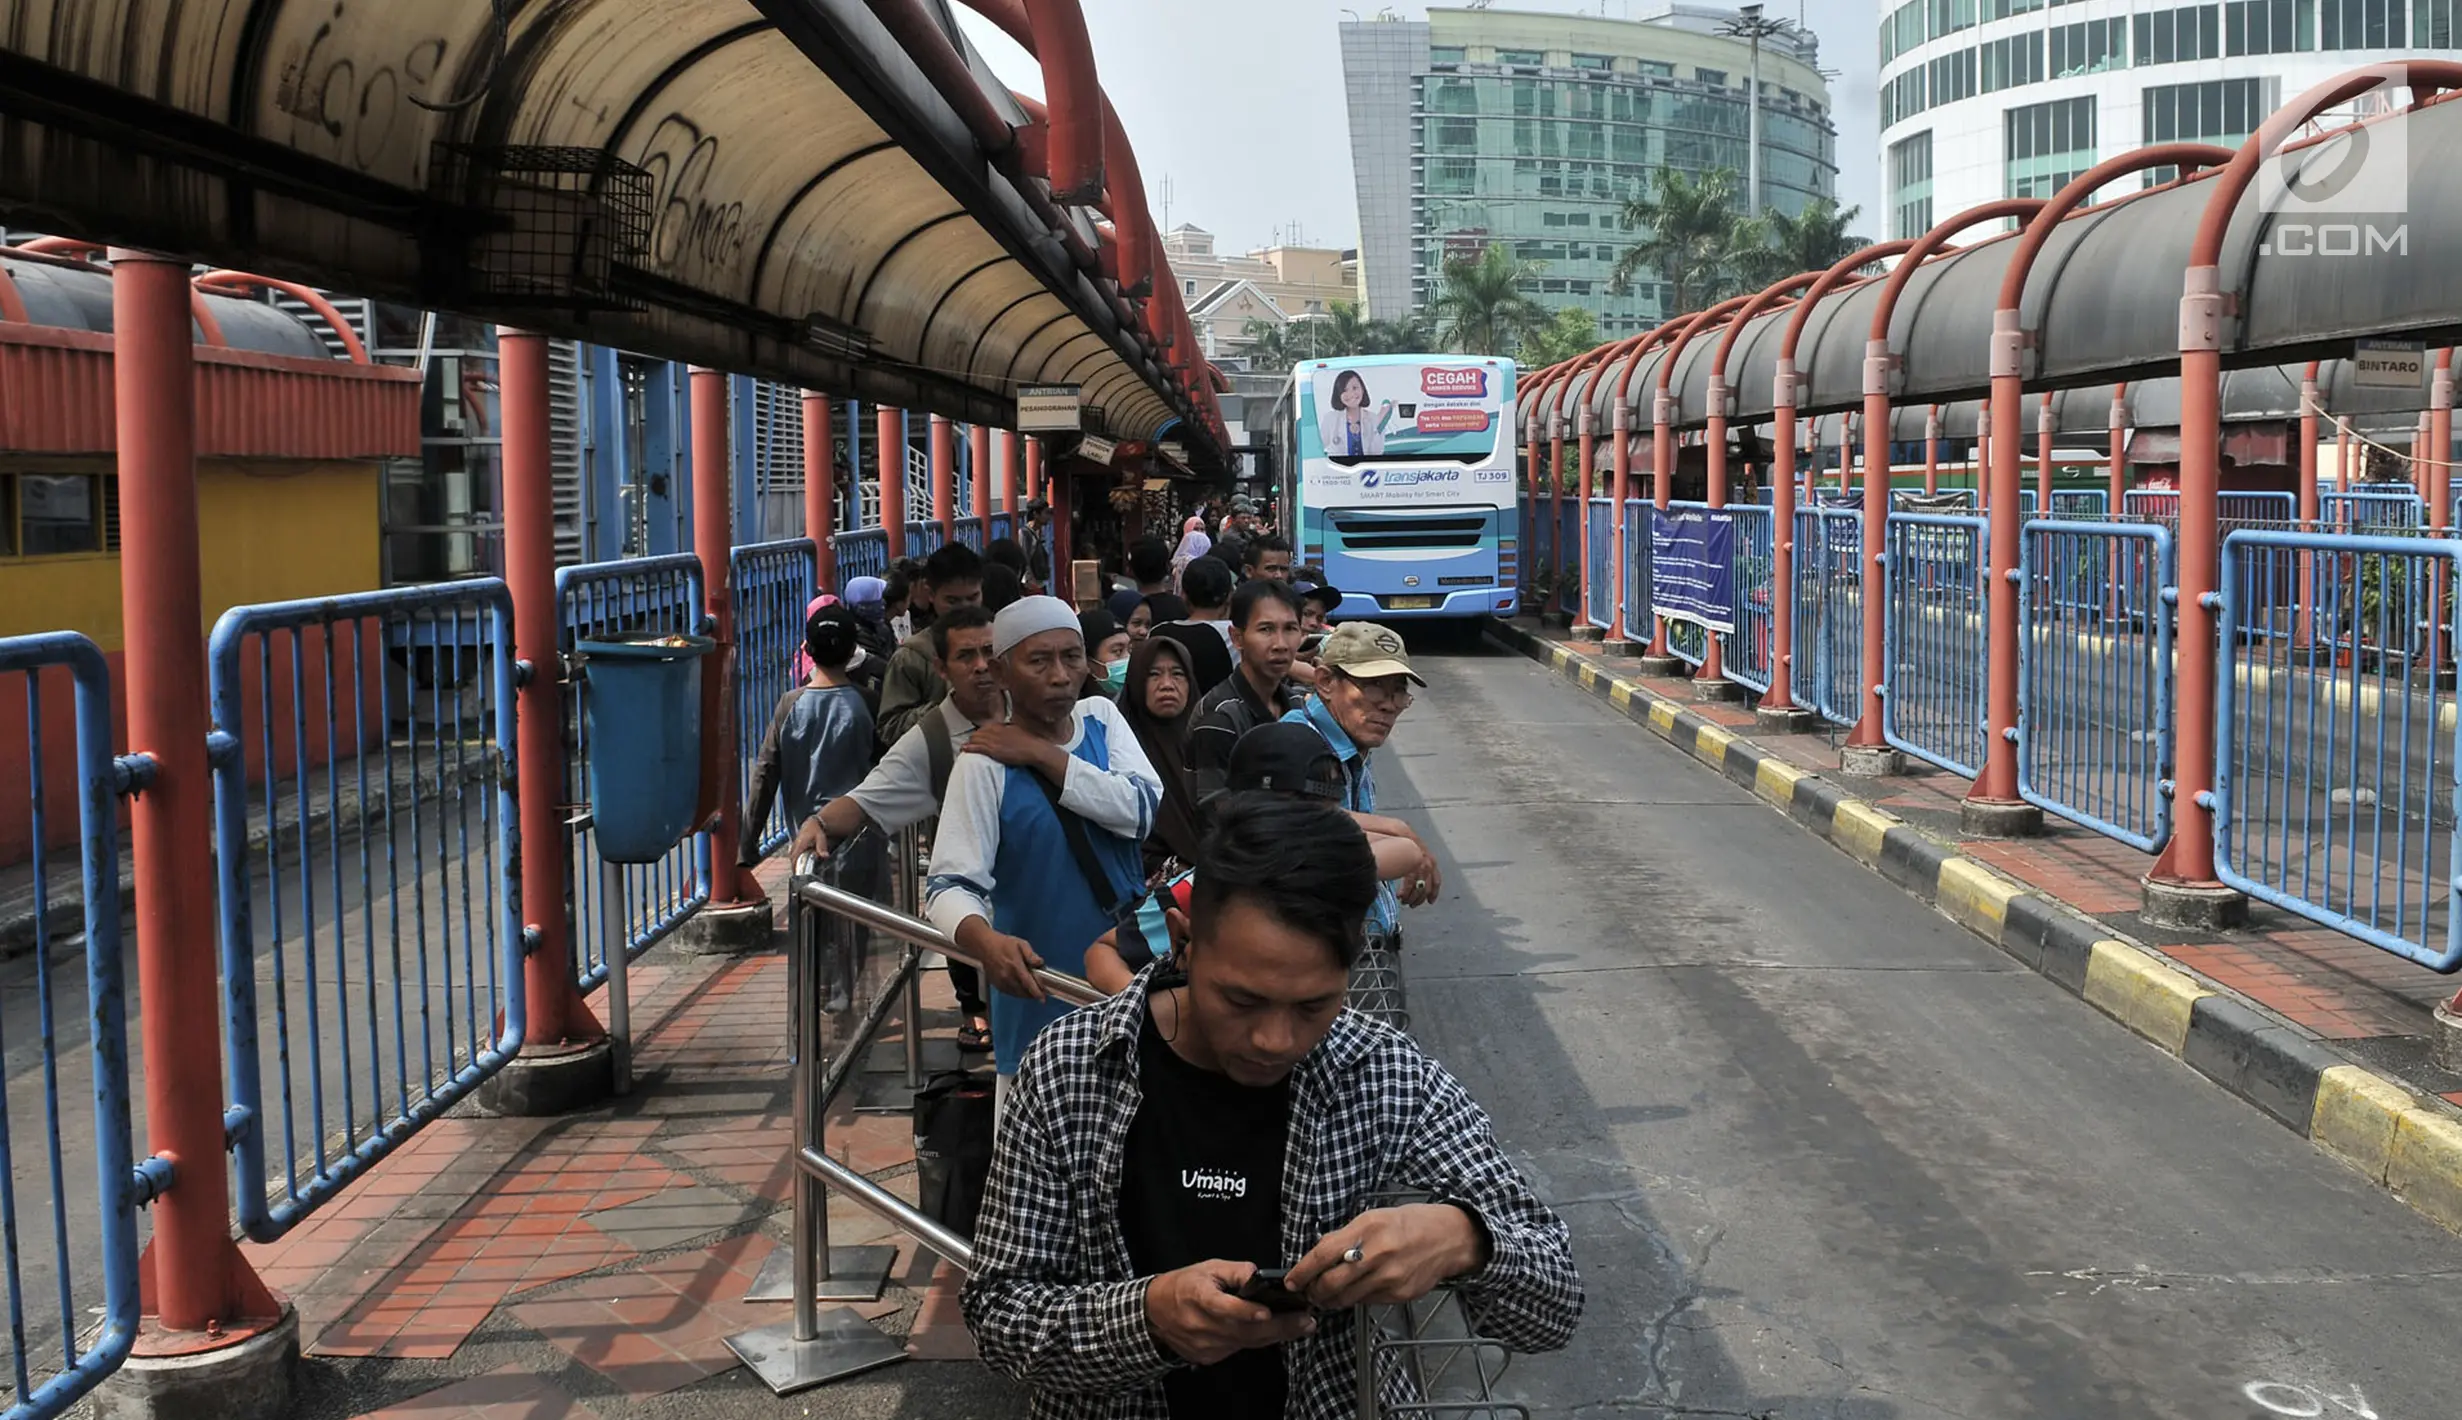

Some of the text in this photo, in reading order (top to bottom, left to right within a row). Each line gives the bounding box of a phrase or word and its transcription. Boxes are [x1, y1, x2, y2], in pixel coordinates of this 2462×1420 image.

[2358, 360, 2419, 373] BINTARO
[1426, 372, 1477, 385] CEGAH
[1384, 469, 1460, 485] transjakarta
[1477, 472, 1507, 480] TJ 309
[1182, 1169, 1246, 1197] Umang
